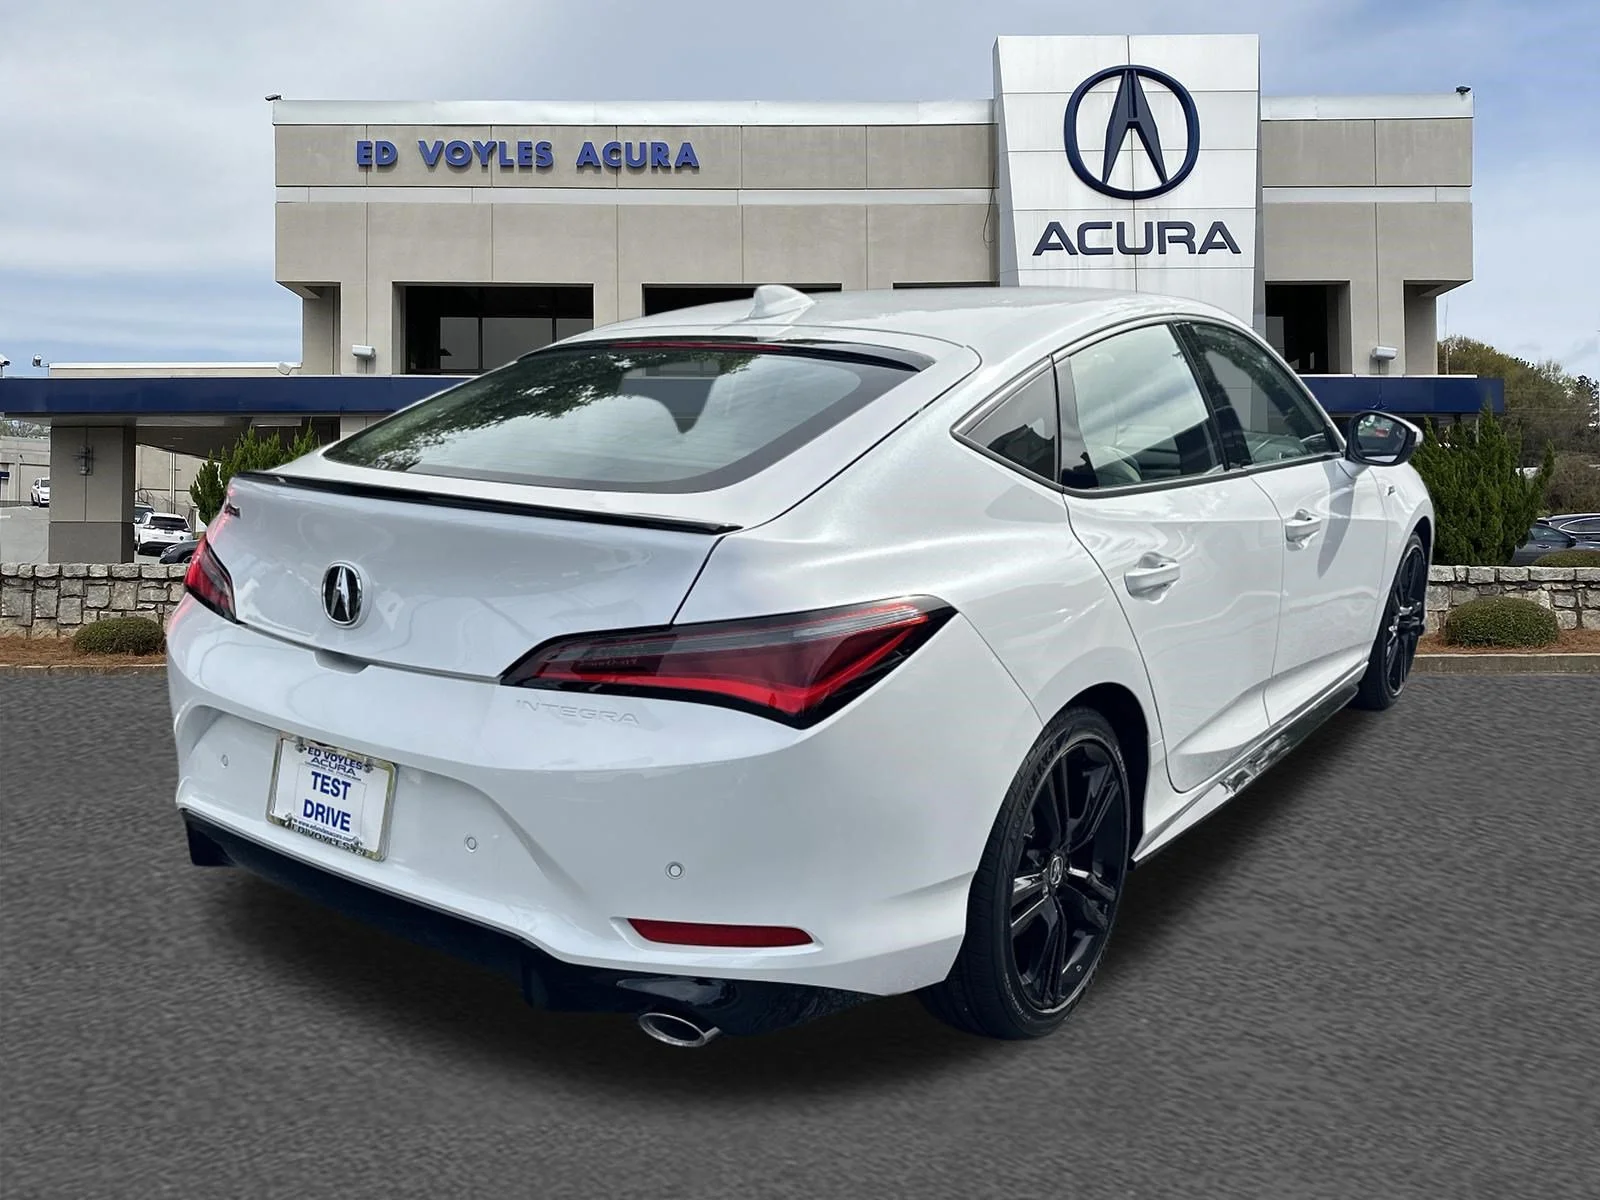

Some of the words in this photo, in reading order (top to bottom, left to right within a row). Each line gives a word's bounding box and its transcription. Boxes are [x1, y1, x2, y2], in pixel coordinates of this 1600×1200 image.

[356, 141, 398, 168] ED
[418, 141, 554, 168] VOYLES
[576, 142, 700, 169] ACURA
[1032, 221, 1242, 256] ACURA
[516, 699, 640, 725] INTEGRA
[308, 747, 321, 757] ED
[323, 750, 363, 770] VOYLES
[310, 757, 356, 776] ACURA
[311, 770, 352, 801] TEST
[302, 798, 352, 832] DRIVE
